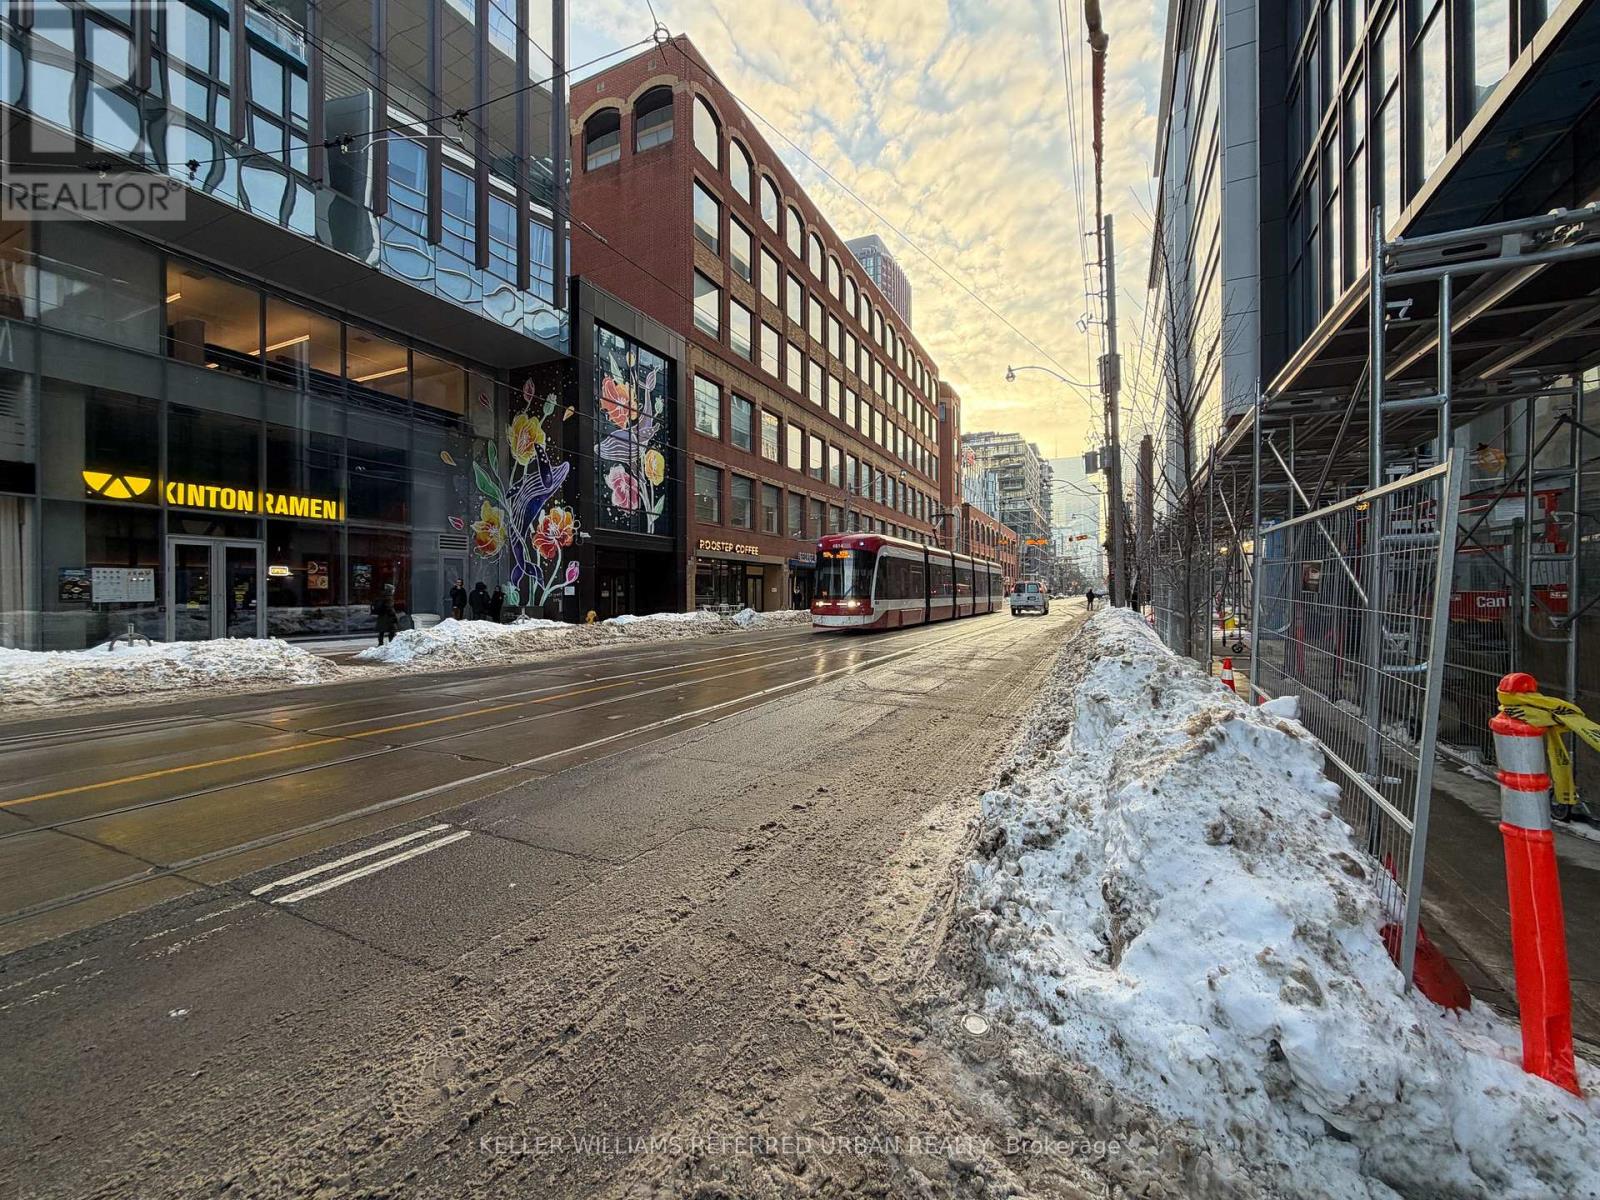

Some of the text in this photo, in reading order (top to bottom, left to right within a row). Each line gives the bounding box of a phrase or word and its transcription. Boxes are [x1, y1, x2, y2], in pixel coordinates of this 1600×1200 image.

[166, 481, 337, 520] KINTON RAMEN
[735, 544, 759, 556] COFFEE
